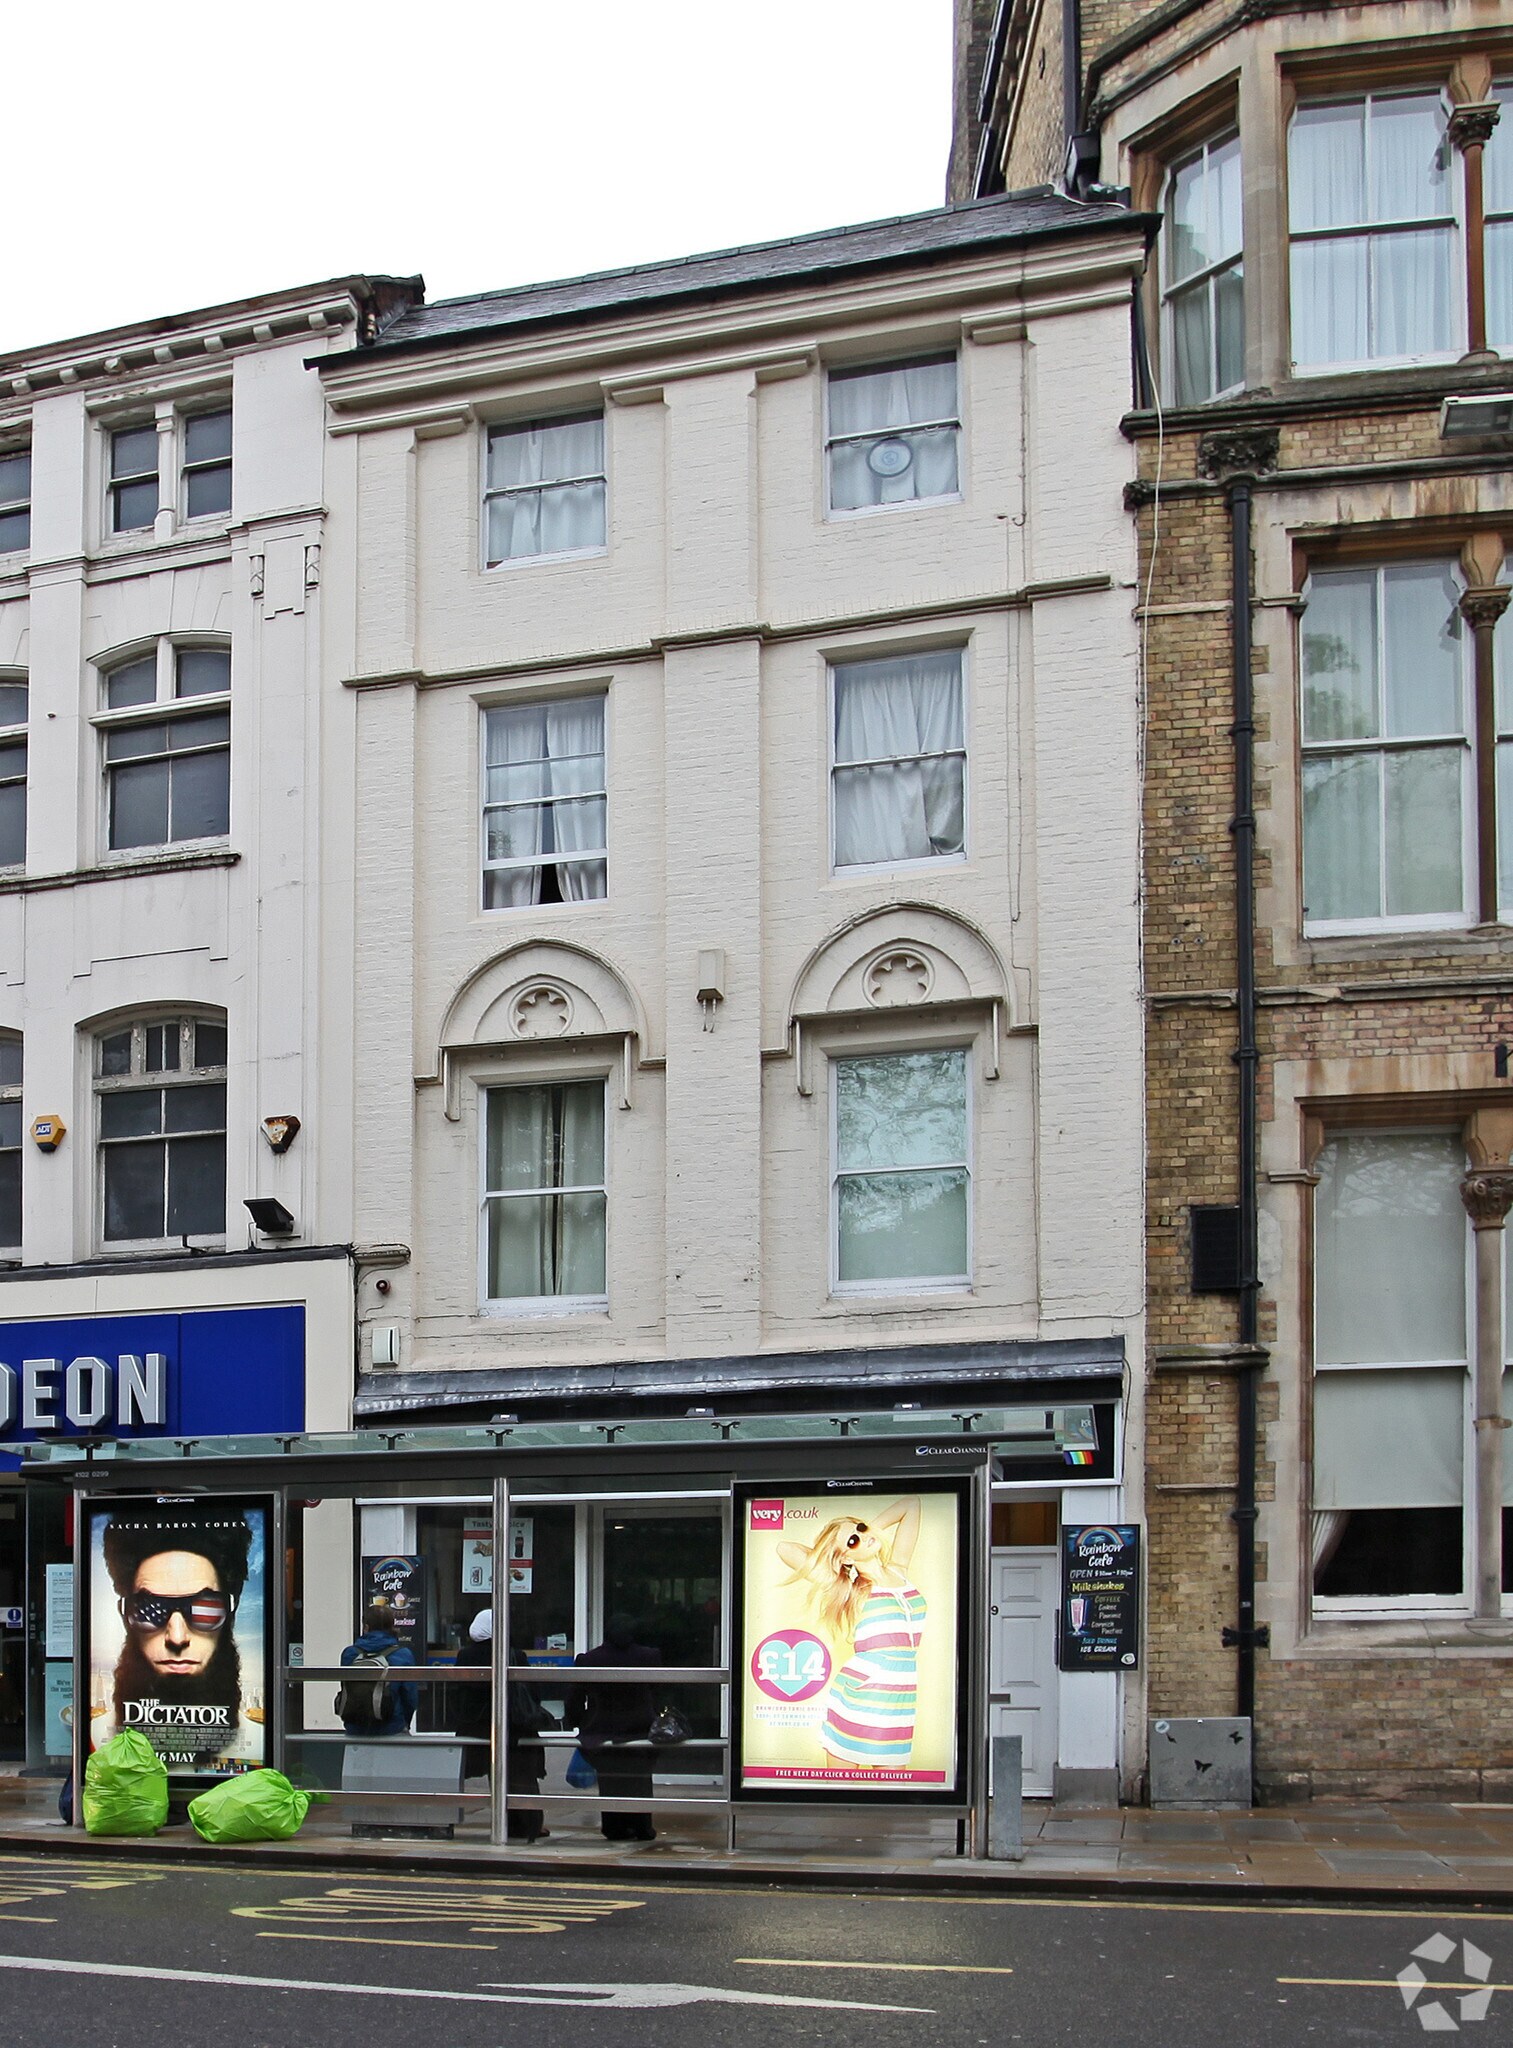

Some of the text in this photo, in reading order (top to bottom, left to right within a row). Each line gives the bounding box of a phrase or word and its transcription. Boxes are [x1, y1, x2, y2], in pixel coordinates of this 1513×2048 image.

[1079, 1543, 1124, 1557] Rainbow
[1088, 1553, 1113, 1567] Cafe
[373, 1569, 412, 1583] Rainbow
[1069, 1569, 1093, 1579] OPEN
[383, 1579, 403, 1591] Cafe
[757, 1650, 826, 1681] £14
[139, 1698, 160, 1707] THE
[123, 1702, 230, 1725] DICTATOR
[169, 1752, 196, 1763] MAY
[775, 1769, 792, 1777] FREE
[793, 1769, 809, 1777] NEXT
[811, 1770, 823, 1778] DAY
[824, 1770, 844, 1779] CLICK
[851, 1771, 879, 1779] COLLECT
[880, 1772, 913, 1780] DELIVERY
